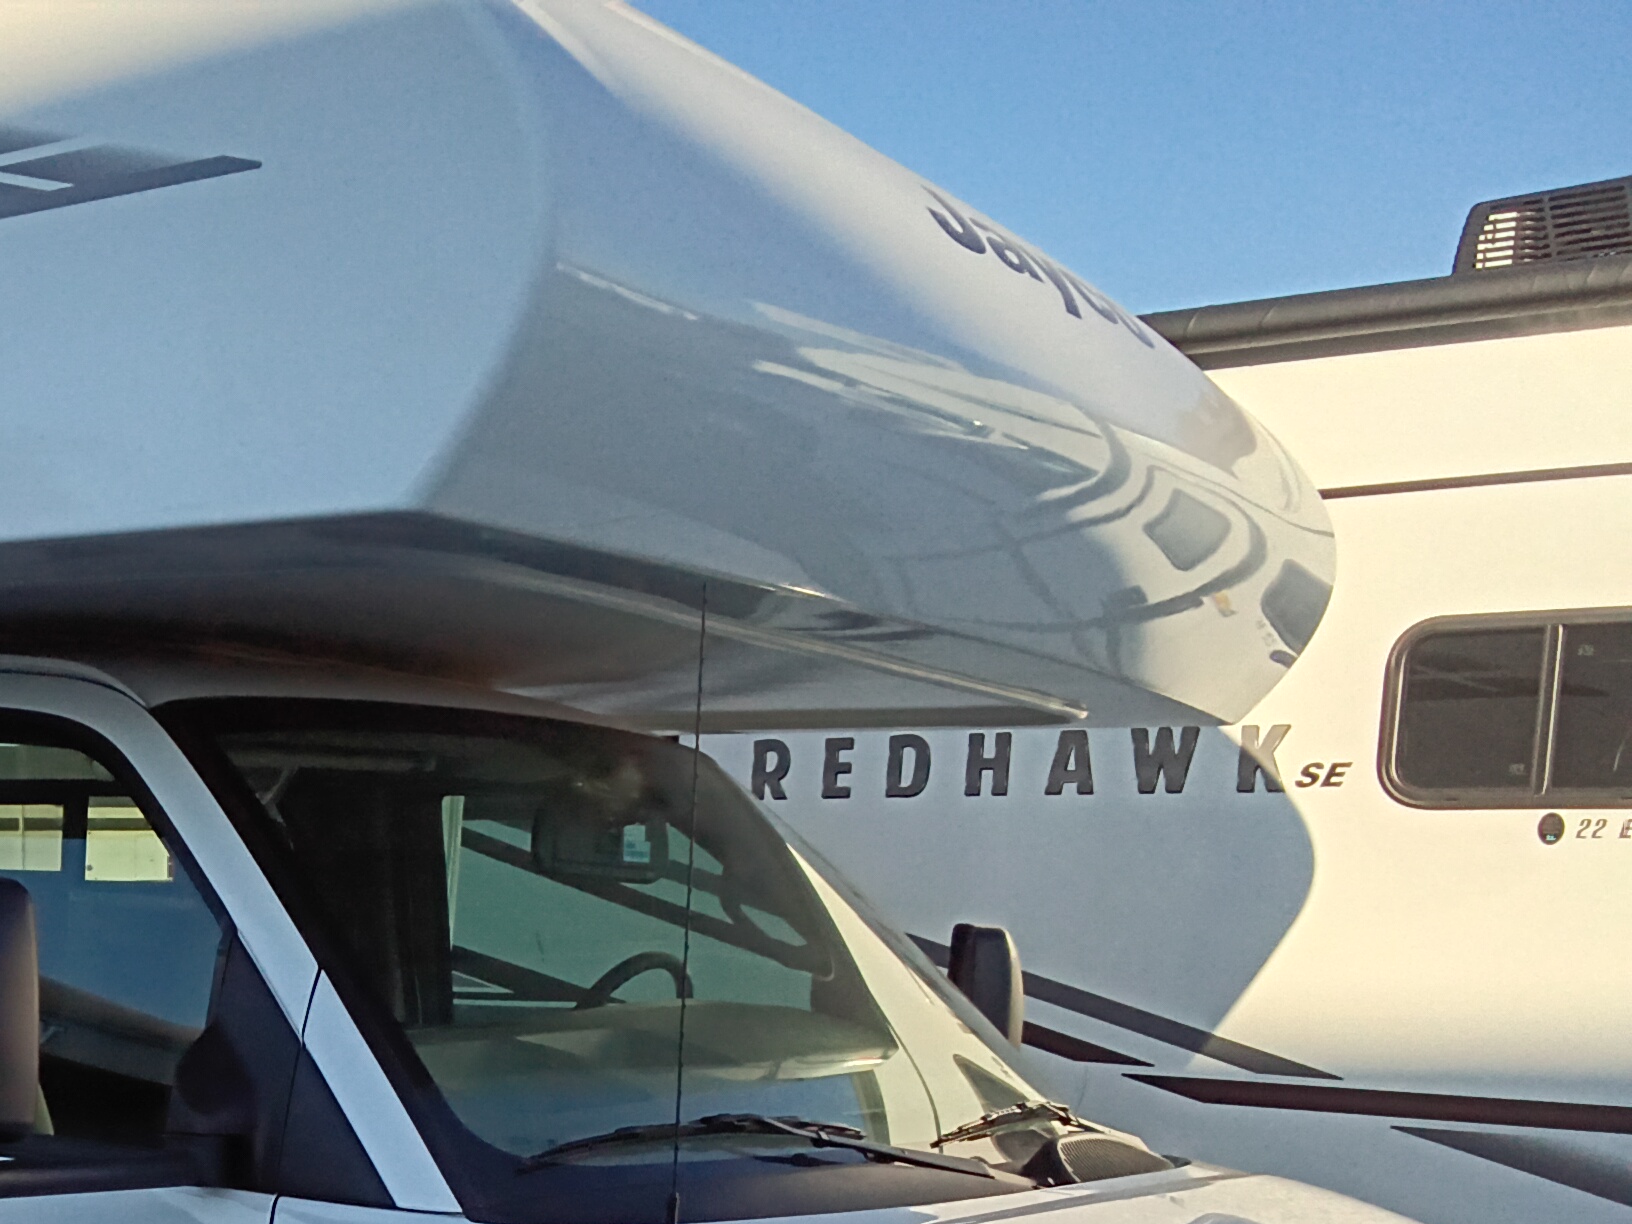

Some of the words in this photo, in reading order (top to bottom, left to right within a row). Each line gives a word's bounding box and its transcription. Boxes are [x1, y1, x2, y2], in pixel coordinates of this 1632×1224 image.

[750, 723, 1292, 801] REDHAWK
[1294, 761, 1353, 789] SE
[1575, 818, 1608, 839] 22
